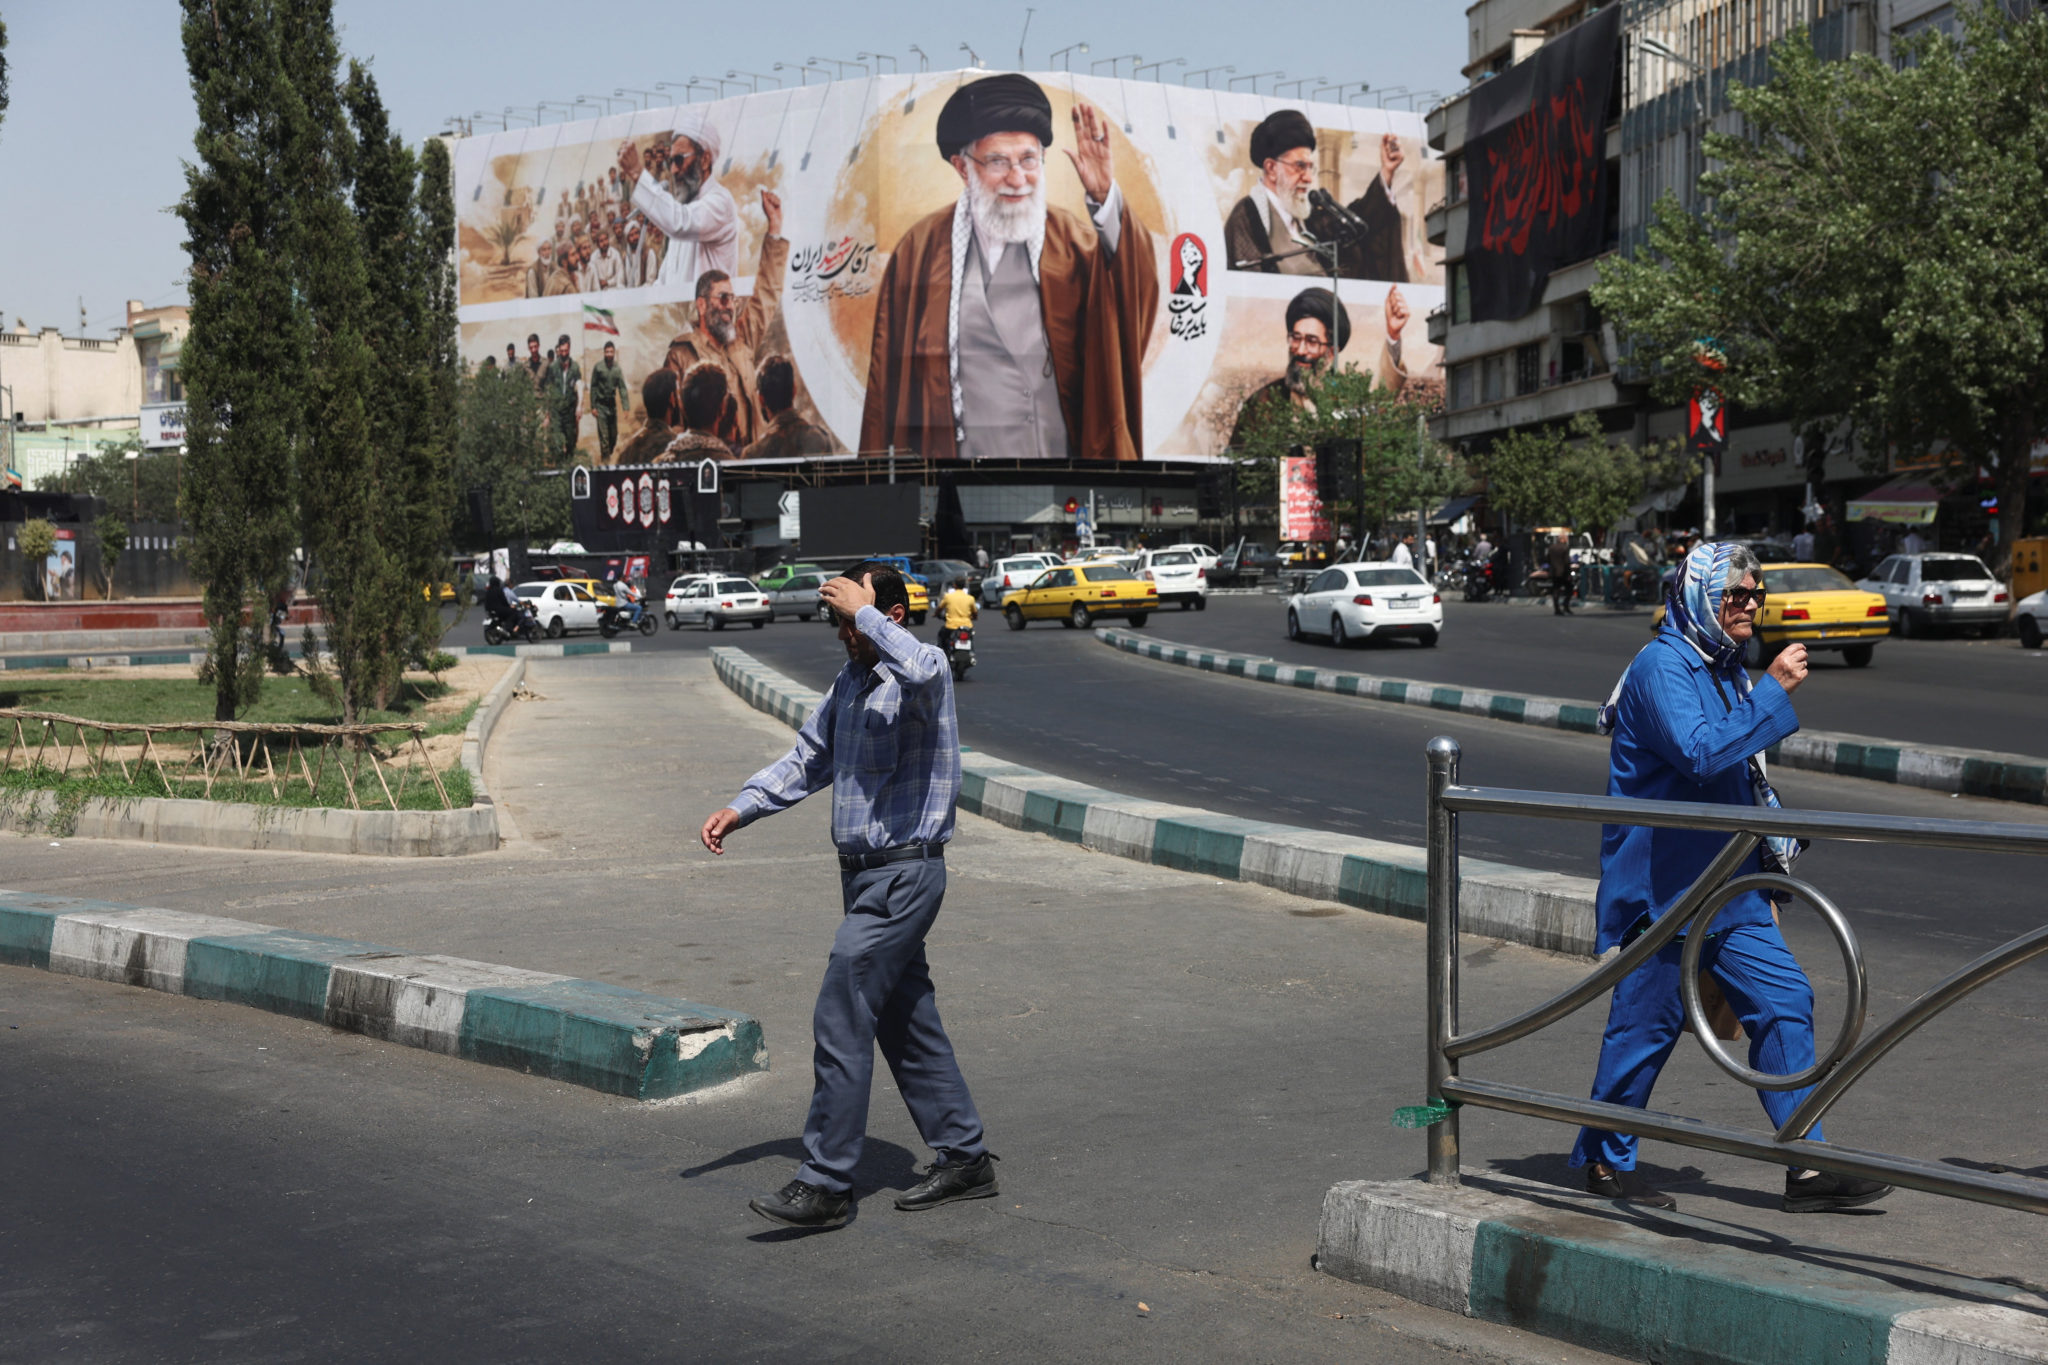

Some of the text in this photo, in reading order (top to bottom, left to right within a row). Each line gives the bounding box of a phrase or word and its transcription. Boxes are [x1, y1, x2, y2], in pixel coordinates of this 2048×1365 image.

[791, 236, 877, 280] آقای شهید ایران
[1187, 312, 1207, 340] باید
